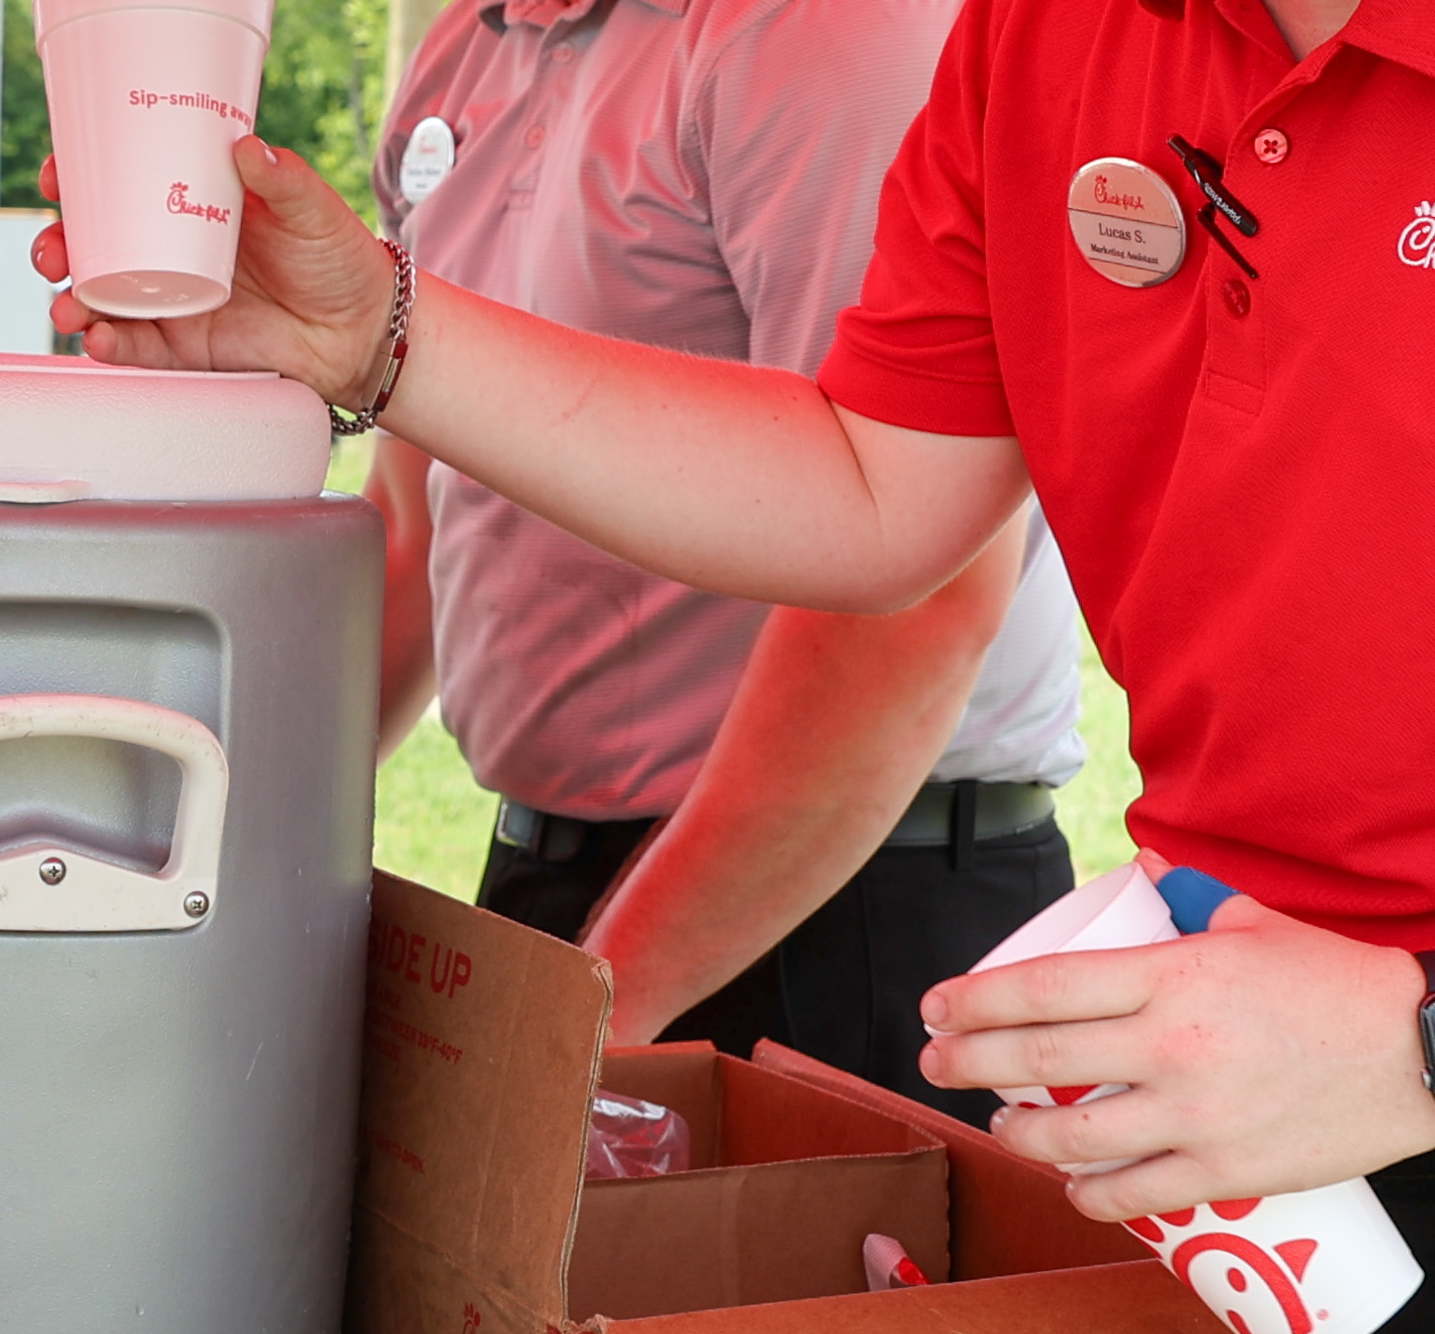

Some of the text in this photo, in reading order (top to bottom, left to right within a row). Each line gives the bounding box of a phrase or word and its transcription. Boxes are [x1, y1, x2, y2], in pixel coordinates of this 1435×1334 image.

[129, 89, 227, 118] Sip-smiling
[1099, 223, 1146, 244] Lucas S.
[1091, 243, 1124, 259] Marketing
[431, 943, 472, 999] UP
